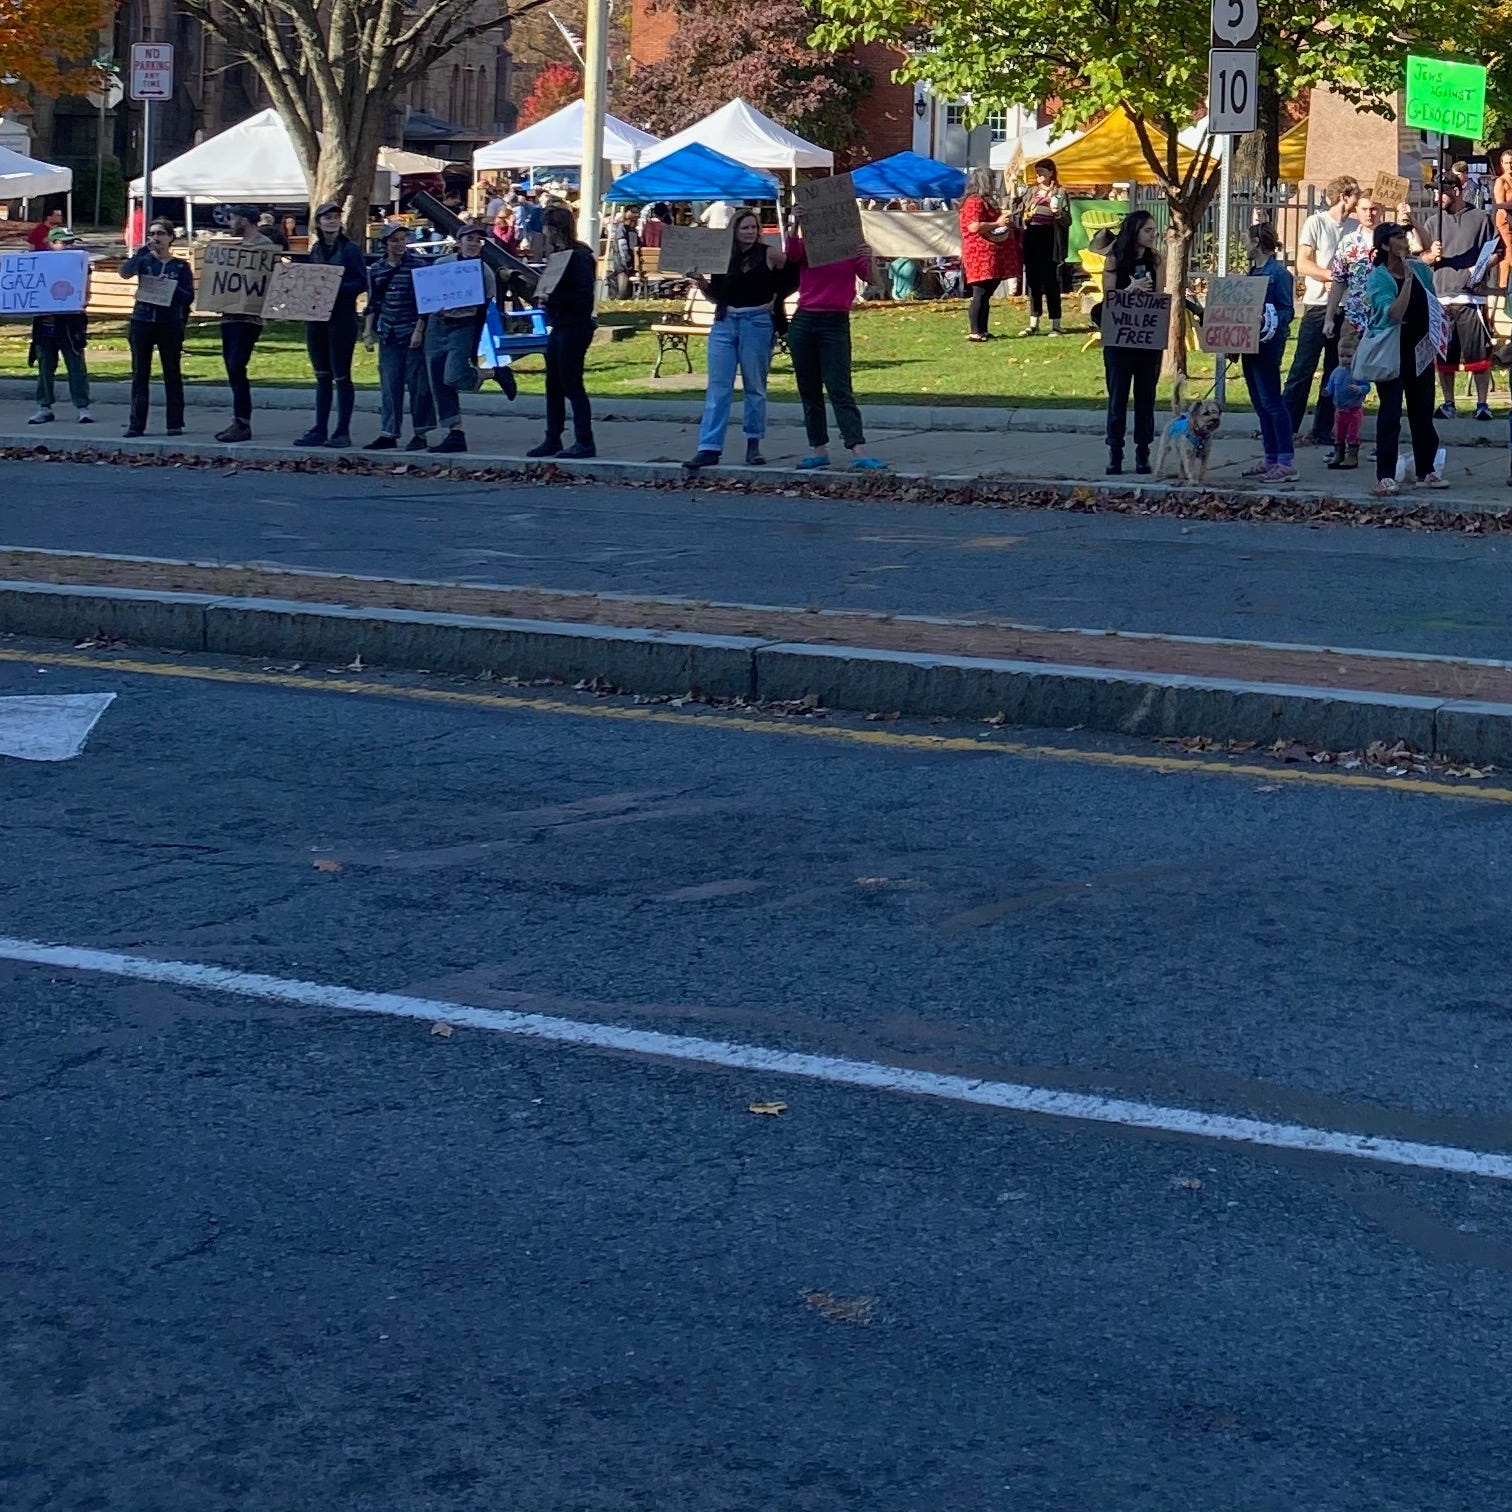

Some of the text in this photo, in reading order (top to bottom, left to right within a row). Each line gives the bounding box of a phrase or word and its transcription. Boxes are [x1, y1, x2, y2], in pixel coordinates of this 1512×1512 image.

[144, 48, 160, 59] NO
[134, 60, 170, 71] PARKING
[143, 80, 160, 88] TIME
[1219, 69, 1248, 114] 10
[1431, 86, 1476, 101] AGAINST
[1407, 97, 1478, 132] GENOCIDE
[1381, 174, 1401, 191] FREE
[1376, 185, 1402, 202] GAZA
[5, 256, 39, 273] LET
[0, 273, 48, 289] GAZA
[211, 270, 268, 298] NOW
[2, 290, 40, 310] LIVE
[1105, 289, 1170, 309] PALESTINE
[1111, 310, 1158, 328] WILL BE
[1115, 326, 1155, 345] FREE
